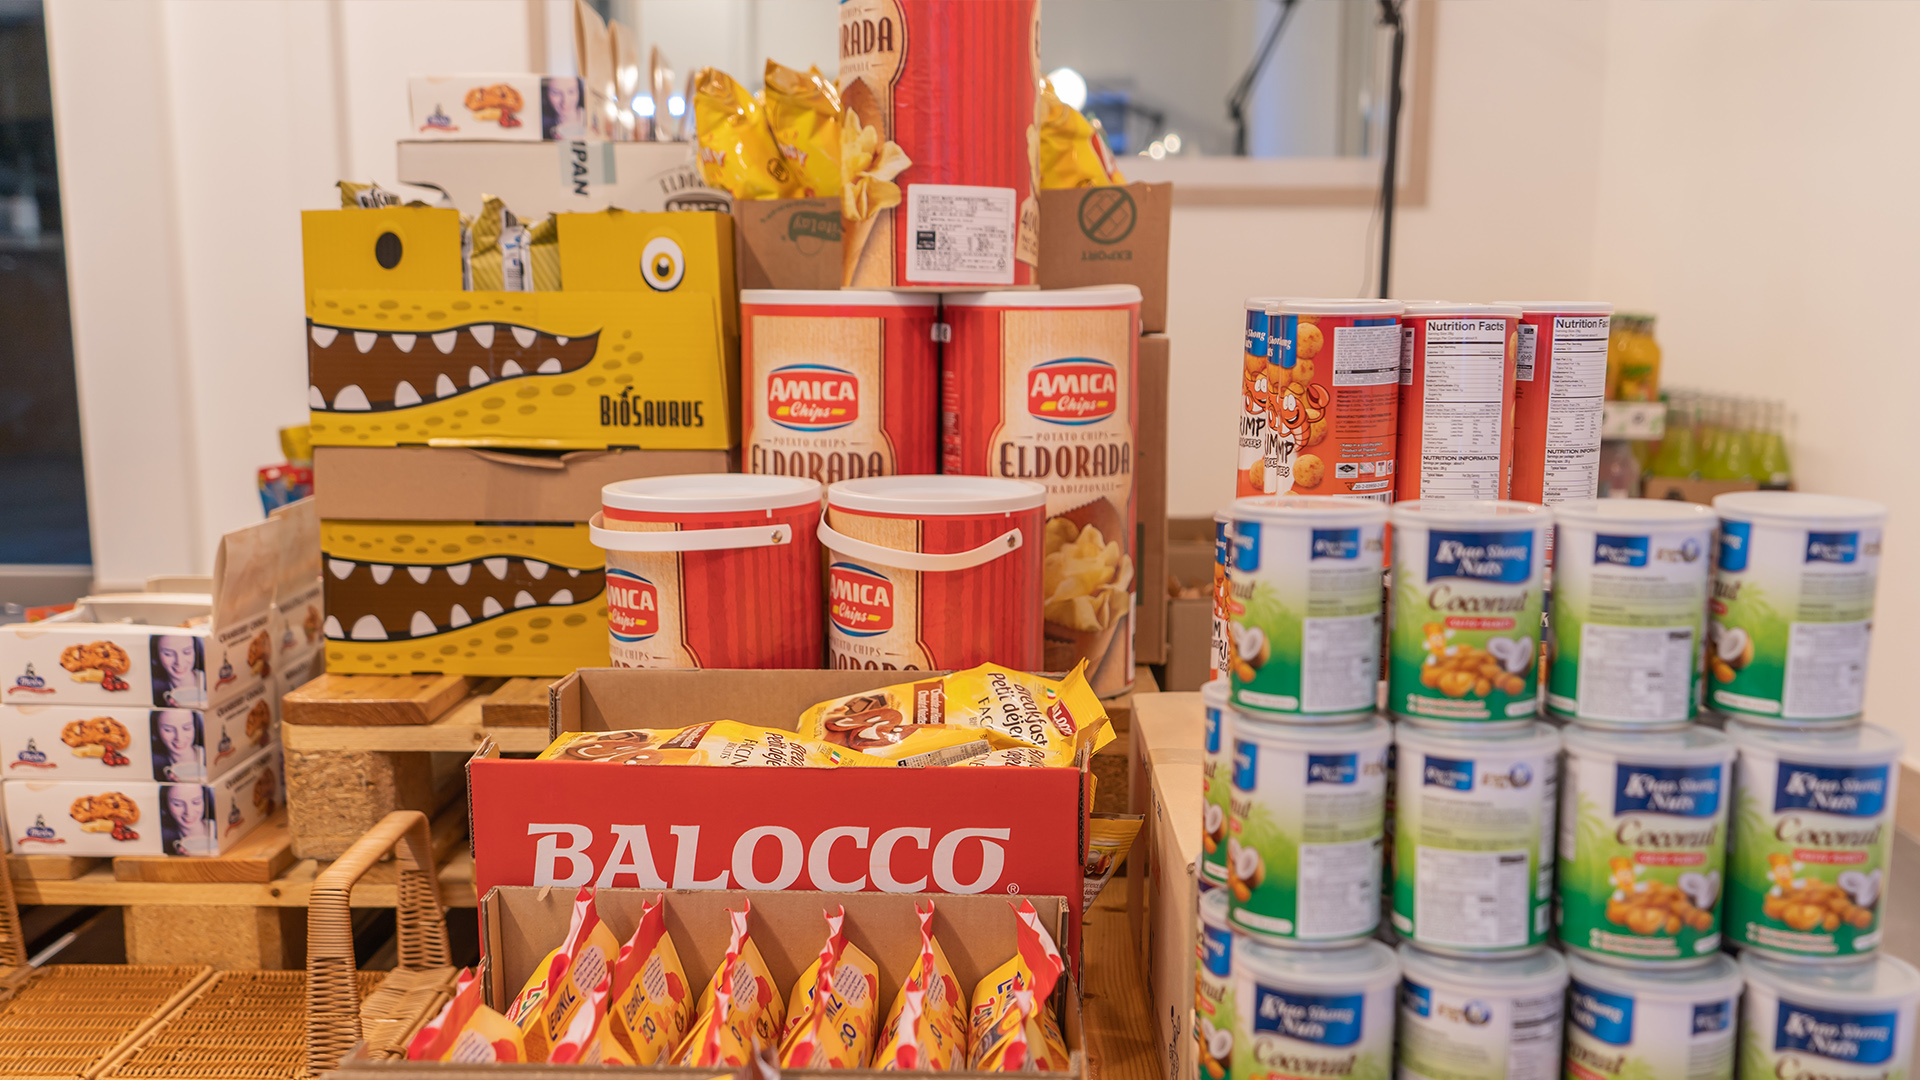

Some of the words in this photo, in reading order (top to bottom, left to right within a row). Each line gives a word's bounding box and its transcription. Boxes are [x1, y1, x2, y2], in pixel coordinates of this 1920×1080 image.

[1428, 321, 1475, 331] Nutrition
[1479, 321, 1504, 331] Facts
[1555, 319, 1597, 328] Nutrition
[770, 377, 856, 402] AMICA
[1031, 372, 1115, 397] AMICA
[790, 402, 830, 422] Chips
[1057, 395, 1097, 415] Chips
[1000, 441, 1130, 478] ELDORADA
[607, 581, 655, 611] MICA
[1429, 584, 1529, 612] Coconut
[839, 602, 867, 626] Chips
[527, 823, 1011, 894] BALOCCO
